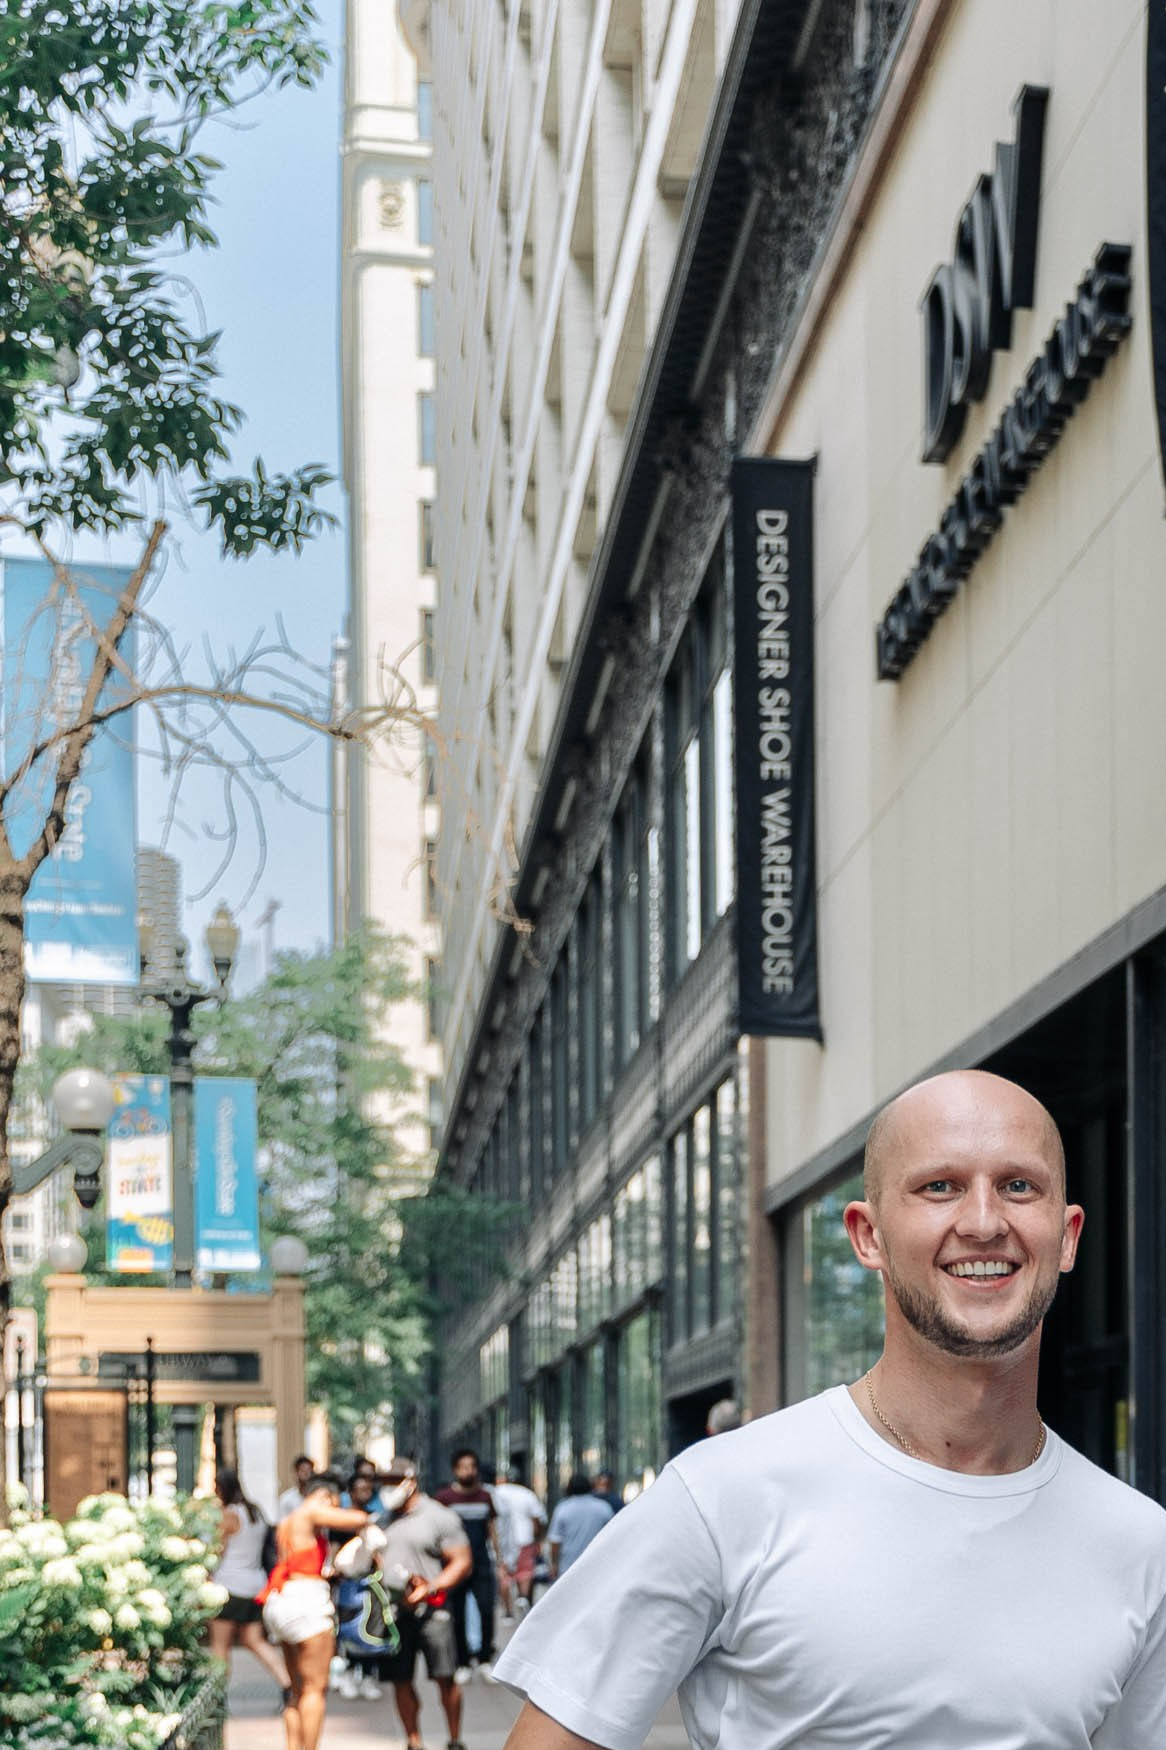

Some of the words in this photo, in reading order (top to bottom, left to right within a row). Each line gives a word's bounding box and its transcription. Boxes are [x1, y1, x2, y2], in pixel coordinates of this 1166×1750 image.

[756, 509, 790, 680] DESIGNER
[758, 687, 792, 781] SHOE
[760, 787, 794, 996] WAREHOUSE
